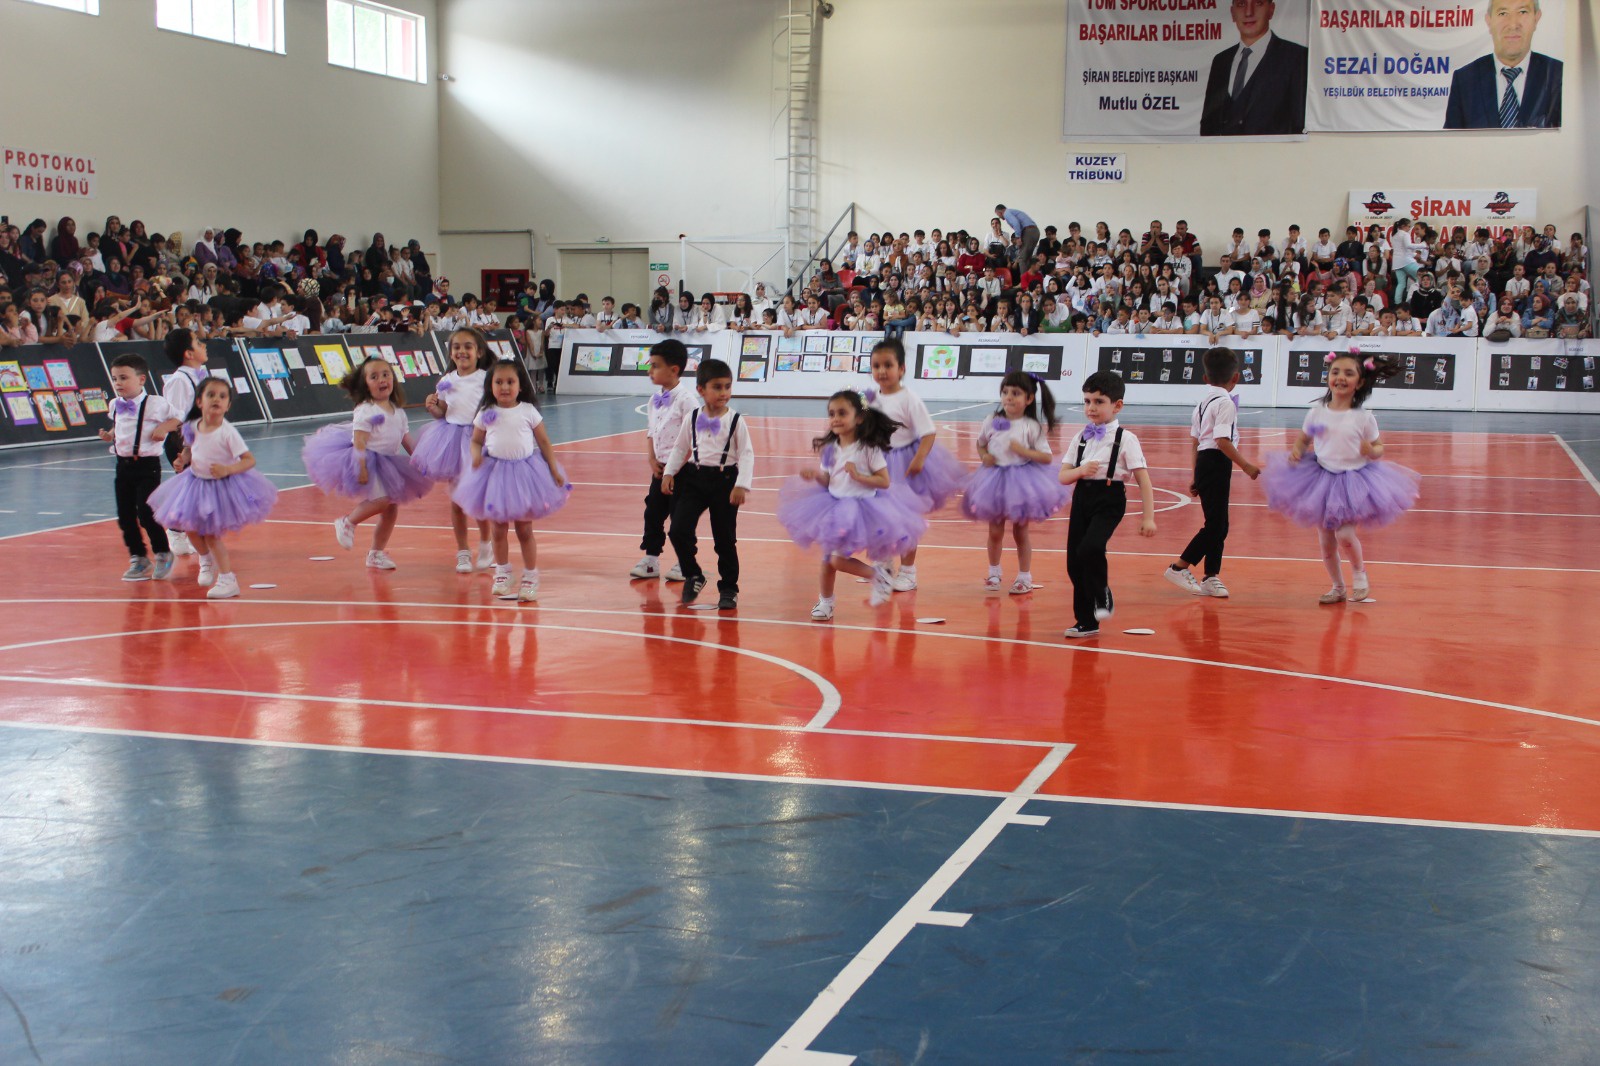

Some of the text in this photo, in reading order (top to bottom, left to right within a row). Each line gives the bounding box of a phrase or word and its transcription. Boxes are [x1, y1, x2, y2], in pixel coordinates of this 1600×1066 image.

[1320, 5, 1474, 32] BAŞARILAR DİLERİM
[1079, 19, 1222, 44] BAŞARILAR DİLERİM
[1324, 53, 1450, 75] SEZAİ DOĞAN
[1082, 68, 1198, 85] ŞİRAN BELEDİYE BAŞKANI
[1099, 93, 1180, 110] Mutlu ÖZEL
[1323, 85, 1449, 99] YEŞİLBÜK BELEDİYE BAŞKANI
[5, 149, 96, 174] PROTOKOL
[1075, 156, 1117, 166] KUZEY
[12, 172, 89, 195] TRİBÜNÜ
[1068, 168, 1123, 180] TRİBÜNÜ
[1410, 196, 1472, 221] ŞİRAN
